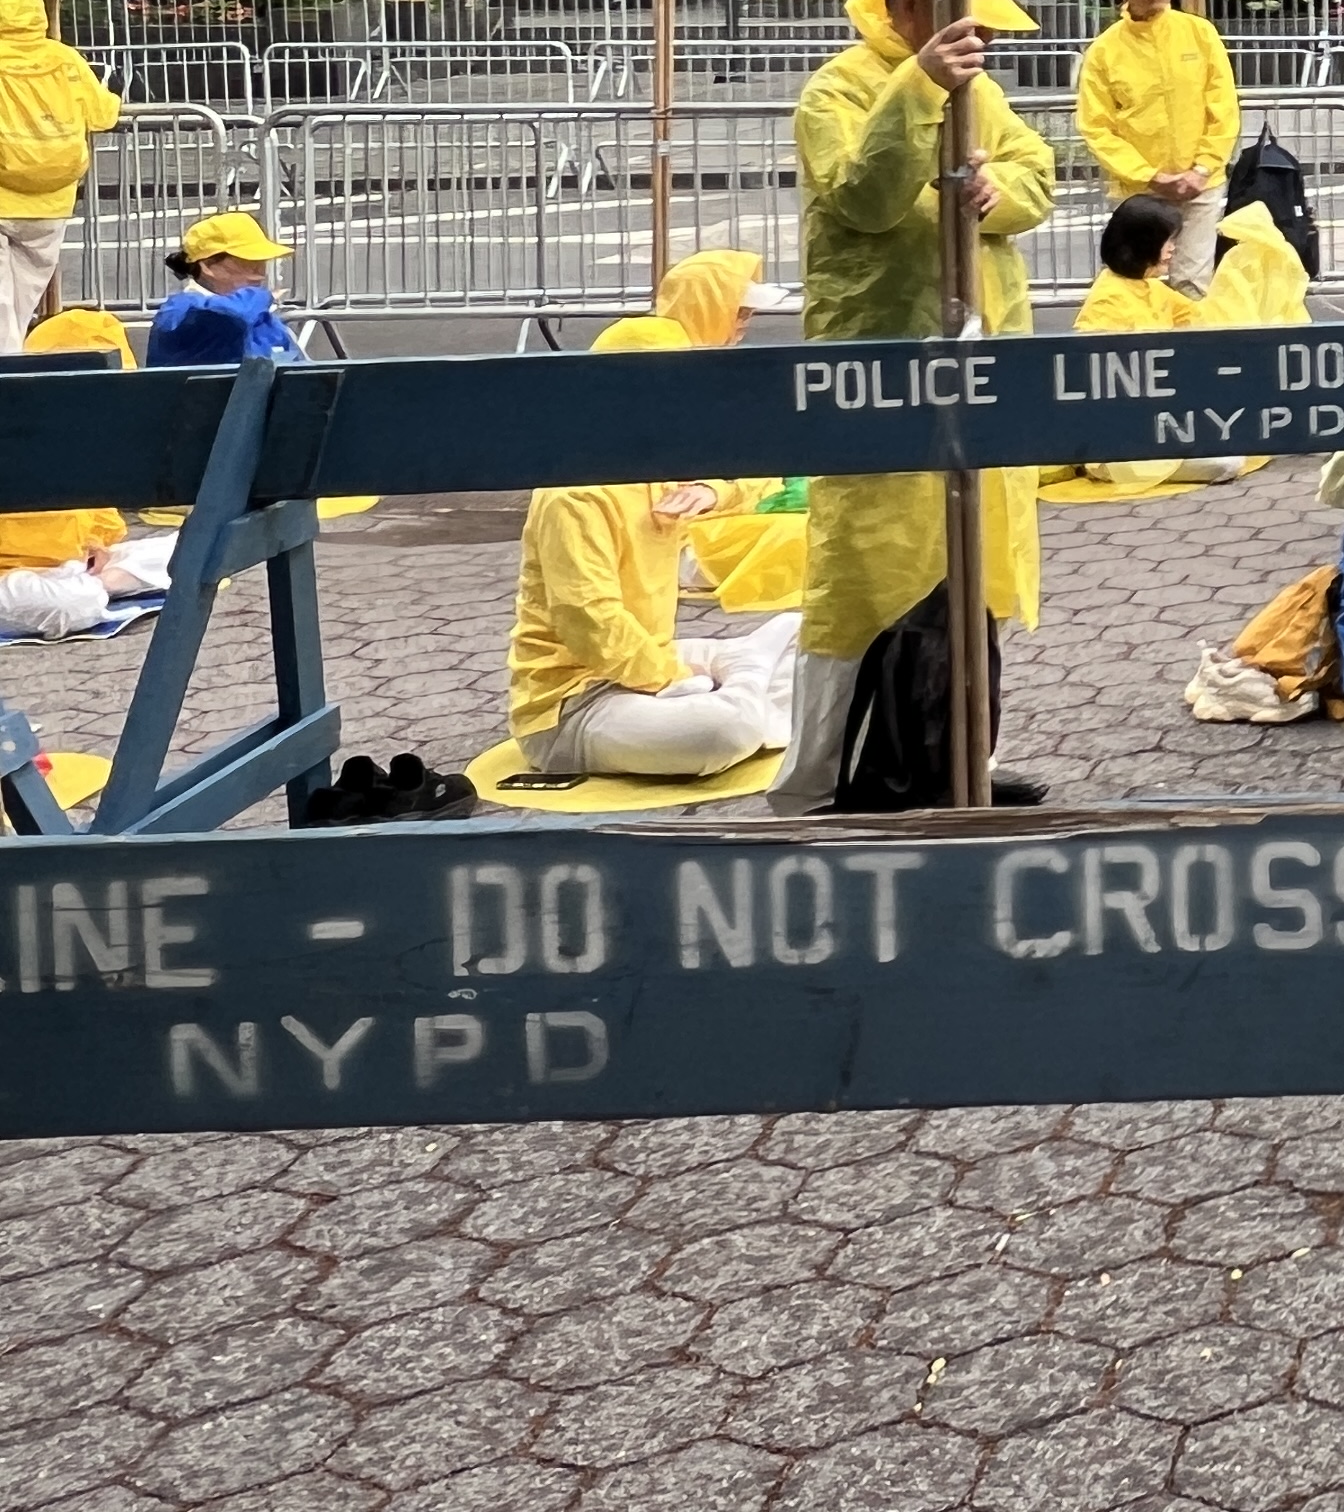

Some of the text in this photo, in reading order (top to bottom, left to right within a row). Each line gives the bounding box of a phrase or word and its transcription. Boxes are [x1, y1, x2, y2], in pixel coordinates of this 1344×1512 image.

[794, 355, 998, 413] POLICE
[1053, 348, 1176, 401] LINE
[1277, 342, 1344, 393] DO
[0, 875, 218, 994] INE
[450, 863, 608, 977] DO
[676, 852, 928, 970] NOT
[168, 1010, 608, 1097] NYPD
